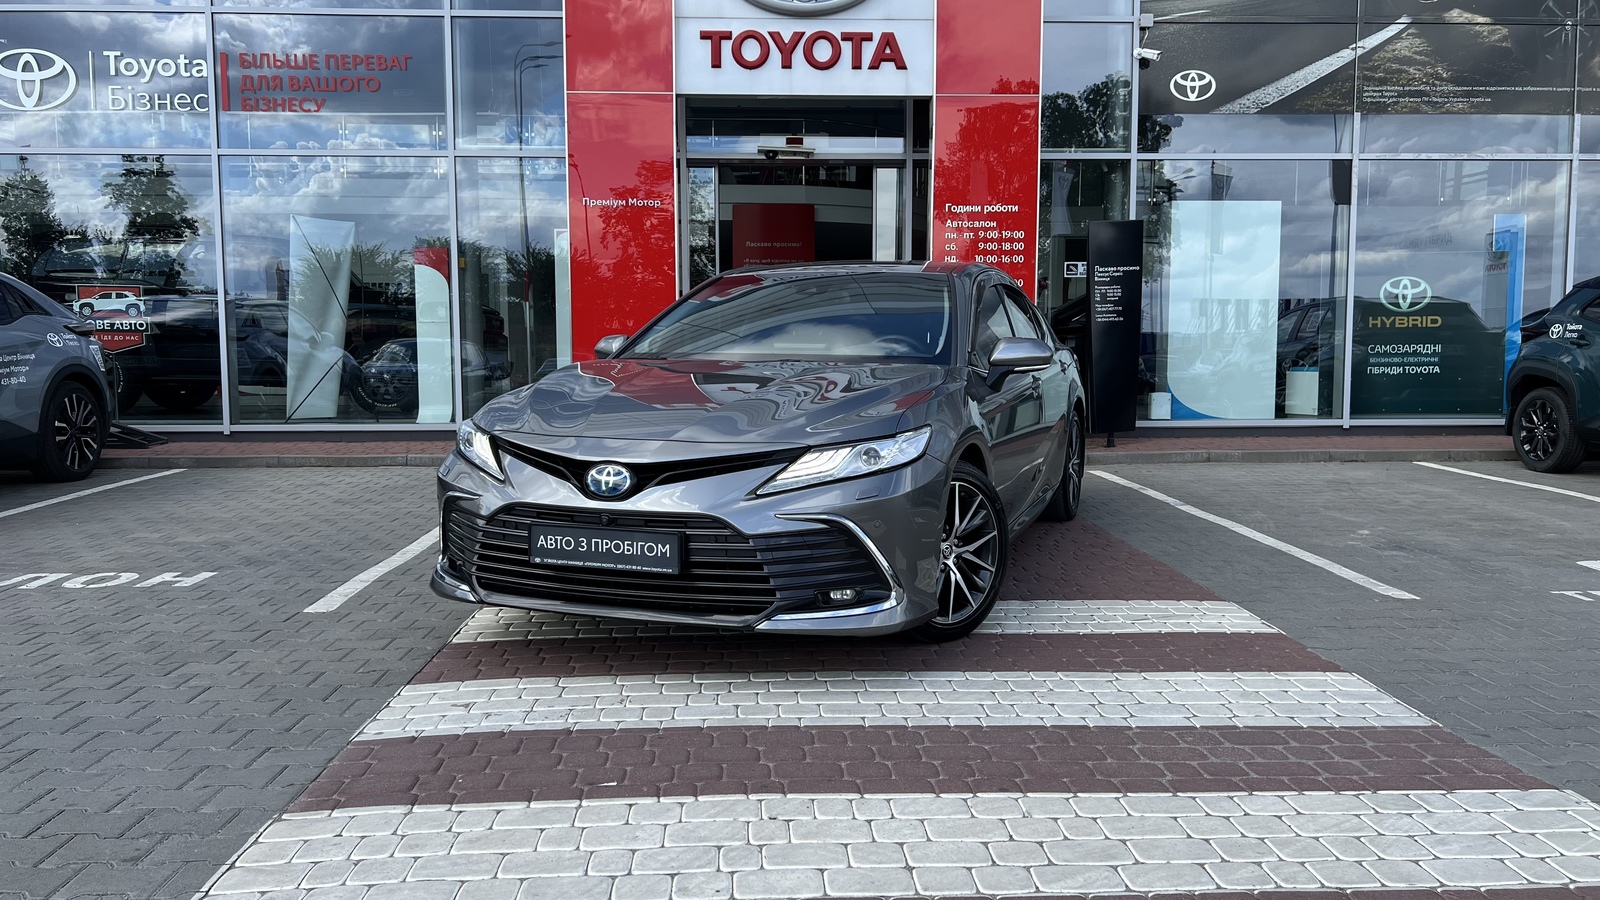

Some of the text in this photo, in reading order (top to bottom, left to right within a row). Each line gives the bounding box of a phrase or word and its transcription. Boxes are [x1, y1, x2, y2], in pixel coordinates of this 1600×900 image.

[699, 29, 909, 71] TOYOTA
[102, 51, 208, 83] Toyota
[238, 53, 413, 71] БІЛЬШЕ ПЕРЕВАГ
[239, 75, 382, 94] ДЛЯ ВАШОГО
[107, 85, 208, 112] Бізнес
[240, 97, 327, 113] БІЗНЕСУ
[582, 197, 661, 208] Преміум Мотор
[945, 203, 1019, 214] Години роботи
[945, 219, 997, 228] Автосалон
[978, 230, 1025, 239] 9:00-19:00
[945, 242, 1024, 251] сб. 9:00-18:00
[974, 254, 1024, 263] 10:00-16:00
[113, 320, 147, 331] АВТО
[1368, 315, 1443, 328] HYBRID
[1367, 343, 1442, 355] САМОЗАРЯДНІ
[1366, 365, 1441, 376] ГІБРИДИ TOYOTA
[537, 534, 671, 558] АВТО З ПРОБІГОМ
